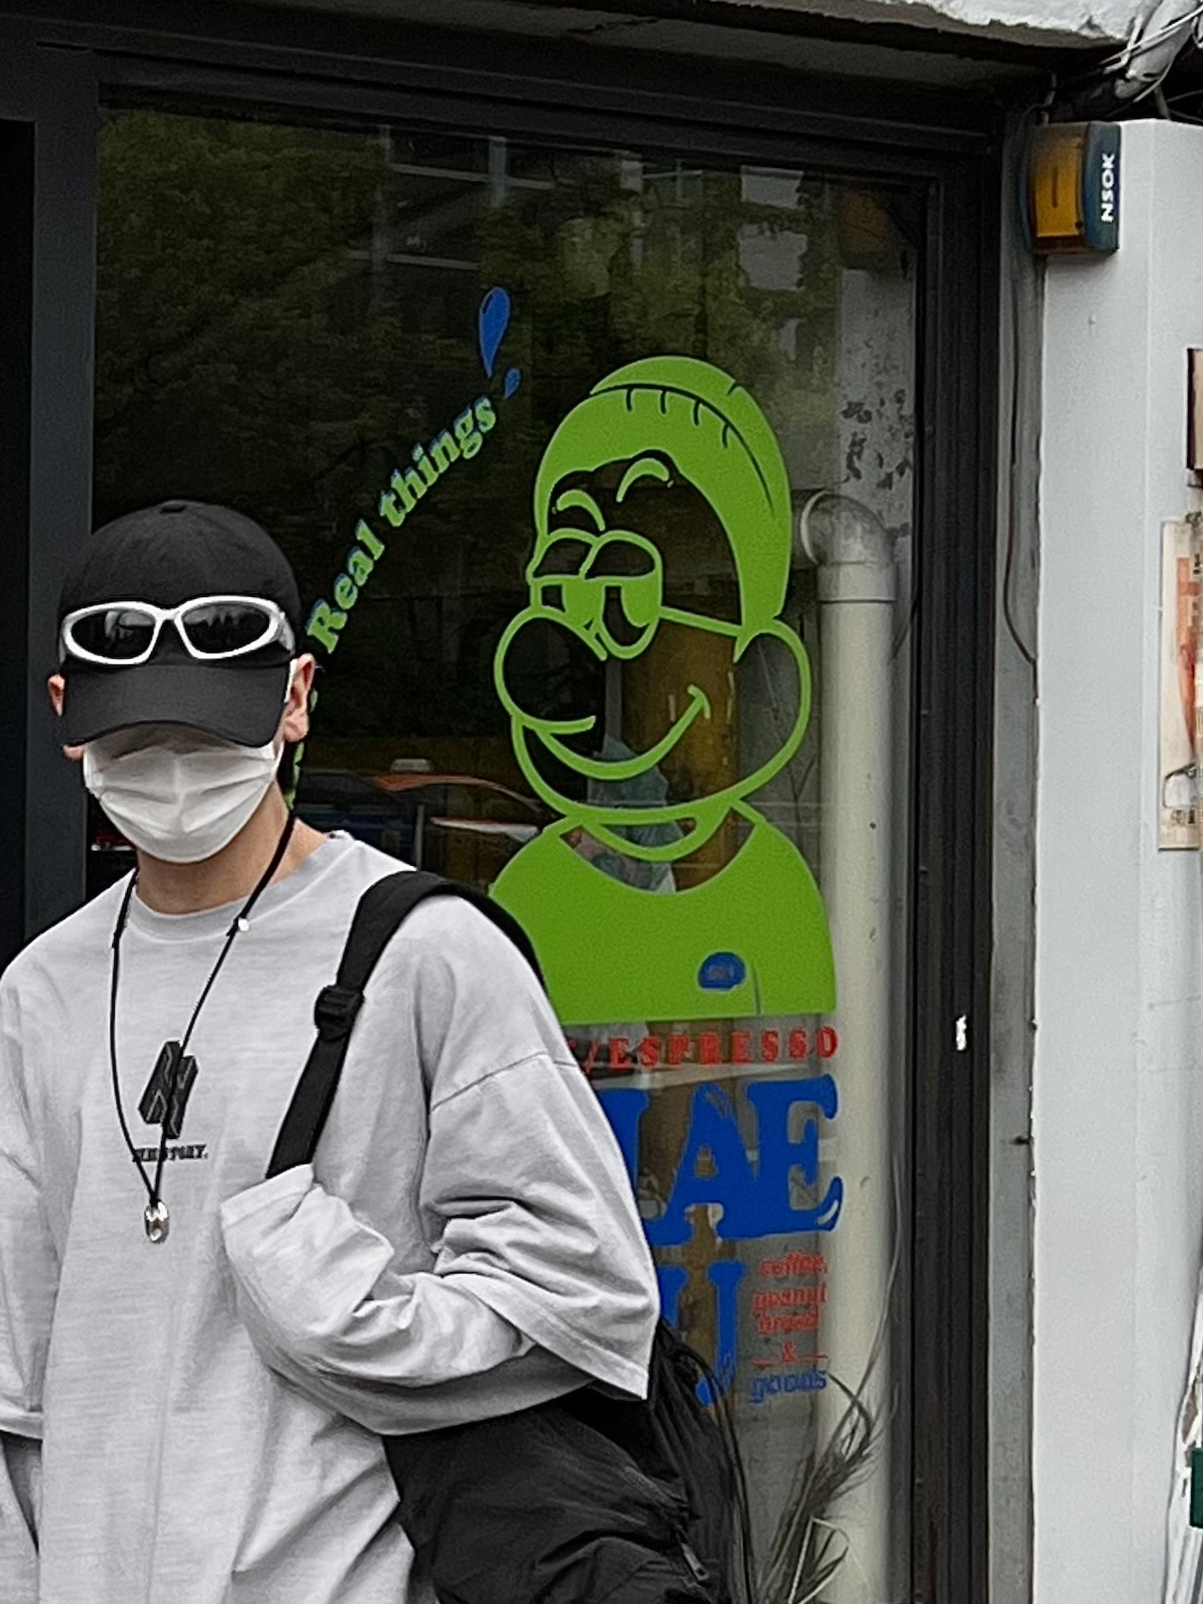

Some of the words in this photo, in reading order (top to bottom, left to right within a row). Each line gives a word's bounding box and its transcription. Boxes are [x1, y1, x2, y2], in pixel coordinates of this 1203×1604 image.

[1100, 153, 1115, 223] NSOK
[304, 517, 385, 655] Real
[378, 394, 497, 528] things
[749, 1367, 828, 1404] goods
